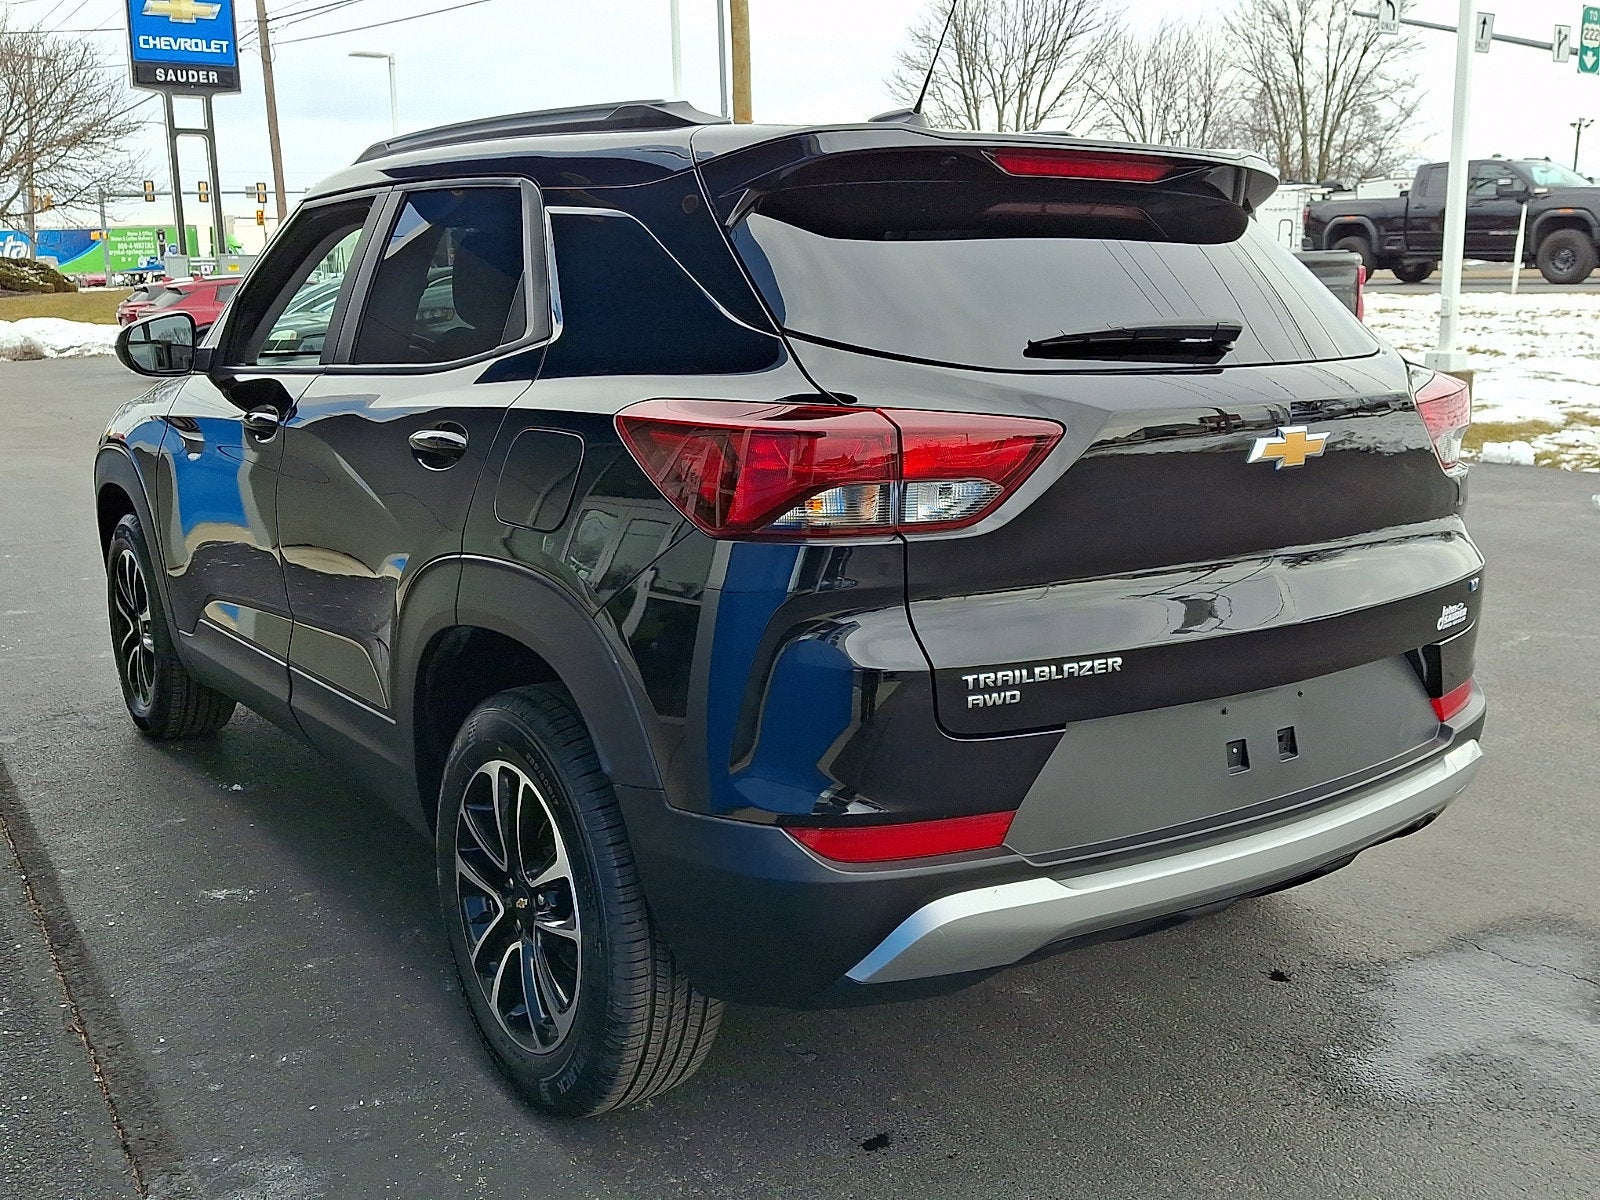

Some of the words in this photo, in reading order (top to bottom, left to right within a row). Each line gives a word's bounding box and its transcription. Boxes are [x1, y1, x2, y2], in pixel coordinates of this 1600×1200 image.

[1584, 27, 1600, 42] 222
[139, 35, 229, 53] CHEVROLET
[155, 67, 219, 84] SAUDER
[962, 657, 1123, 690] TRAILBLAZER
[967, 690, 1021, 709] AWD
